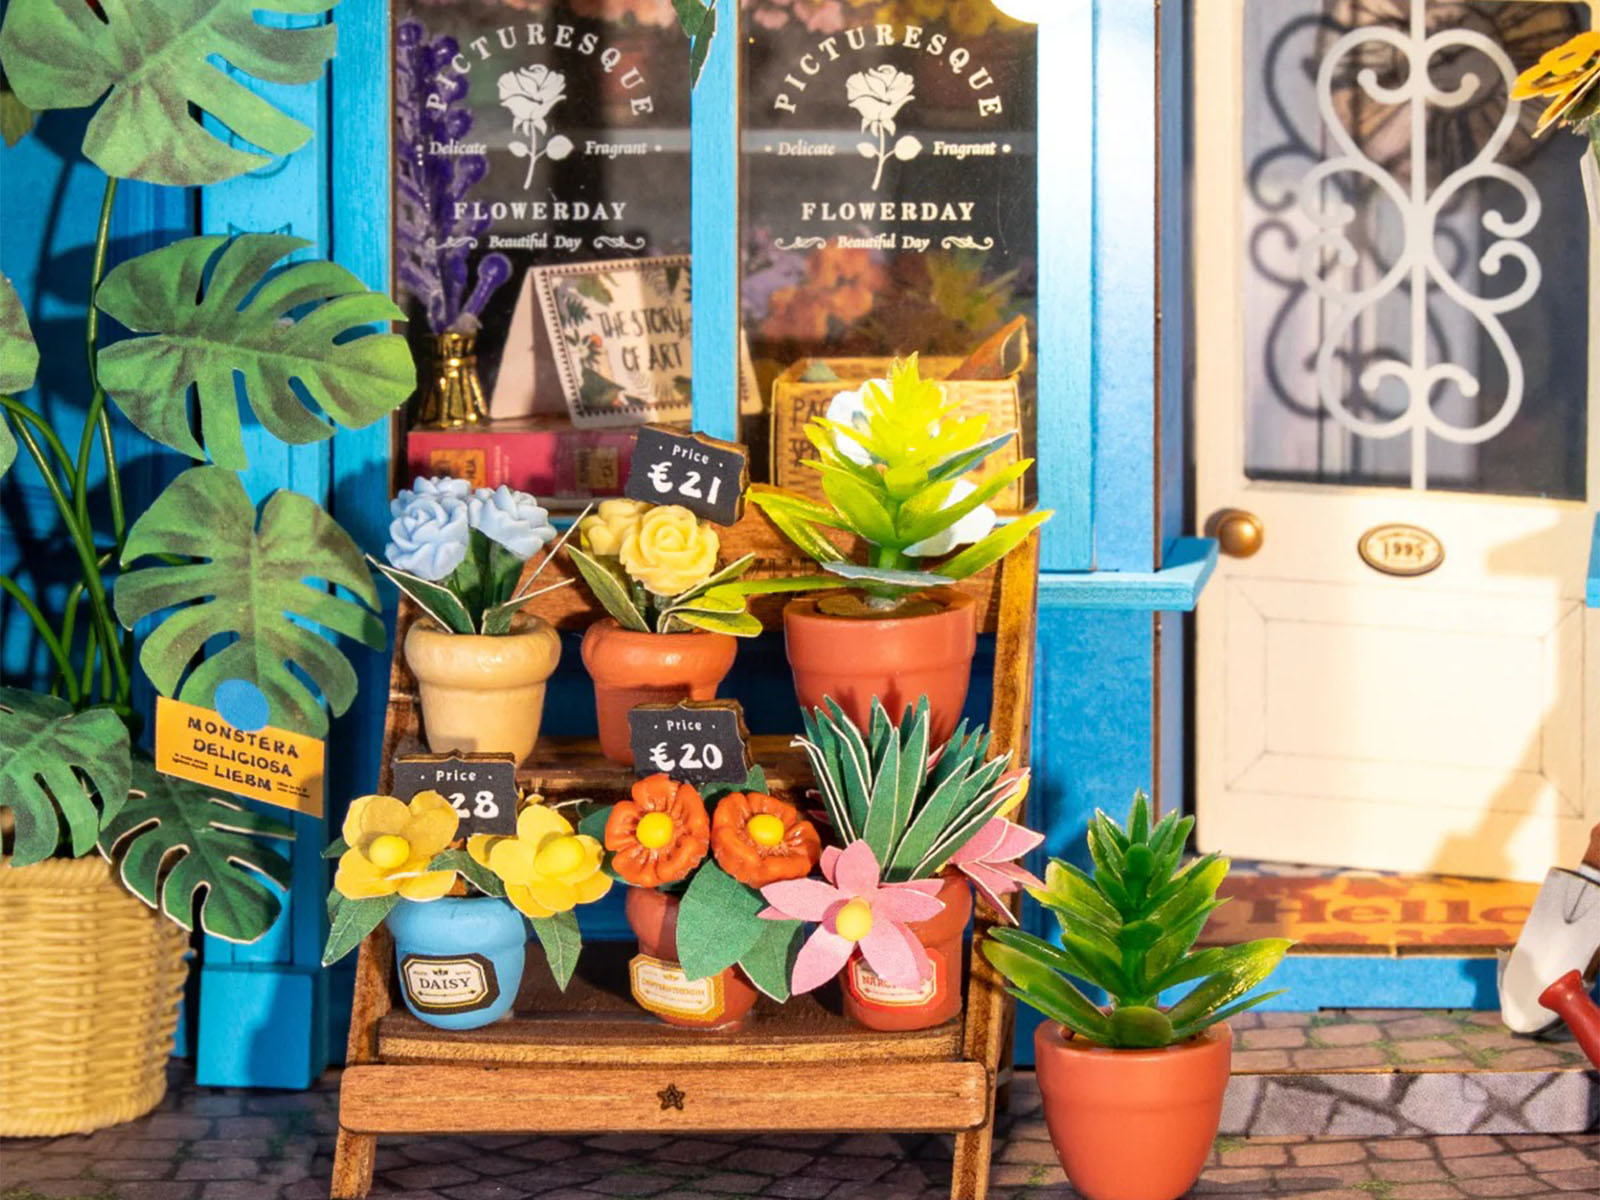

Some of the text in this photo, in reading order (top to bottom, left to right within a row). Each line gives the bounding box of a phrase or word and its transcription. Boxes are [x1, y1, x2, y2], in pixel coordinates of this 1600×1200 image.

[426, 23, 654, 116] PICTURESQUE
[774, 23, 1002, 117] PICTURESQUE
[429, 140, 648, 159] Delicate Fragrant
[777, 139, 997, 160] Delicate Fragrant
[453, 202, 627, 221] FLOWERDAY
[801, 202, 976, 222] FLOWERDAY
[488, 233, 582, 252] Beautiful Day
[836, 233, 931, 252] Beautiful Day
[648, 342, 683, 372] ART
[672, 444, 710, 465] Price
[666, 719, 702, 732] Price
[187, 716, 299, 759] MONSTERA
[193, 738, 293, 777] DELICIOSA
[214, 764, 272, 792] LIEBM
[435, 770, 477, 782] Price
[419, 977, 472, 991] DAISY
